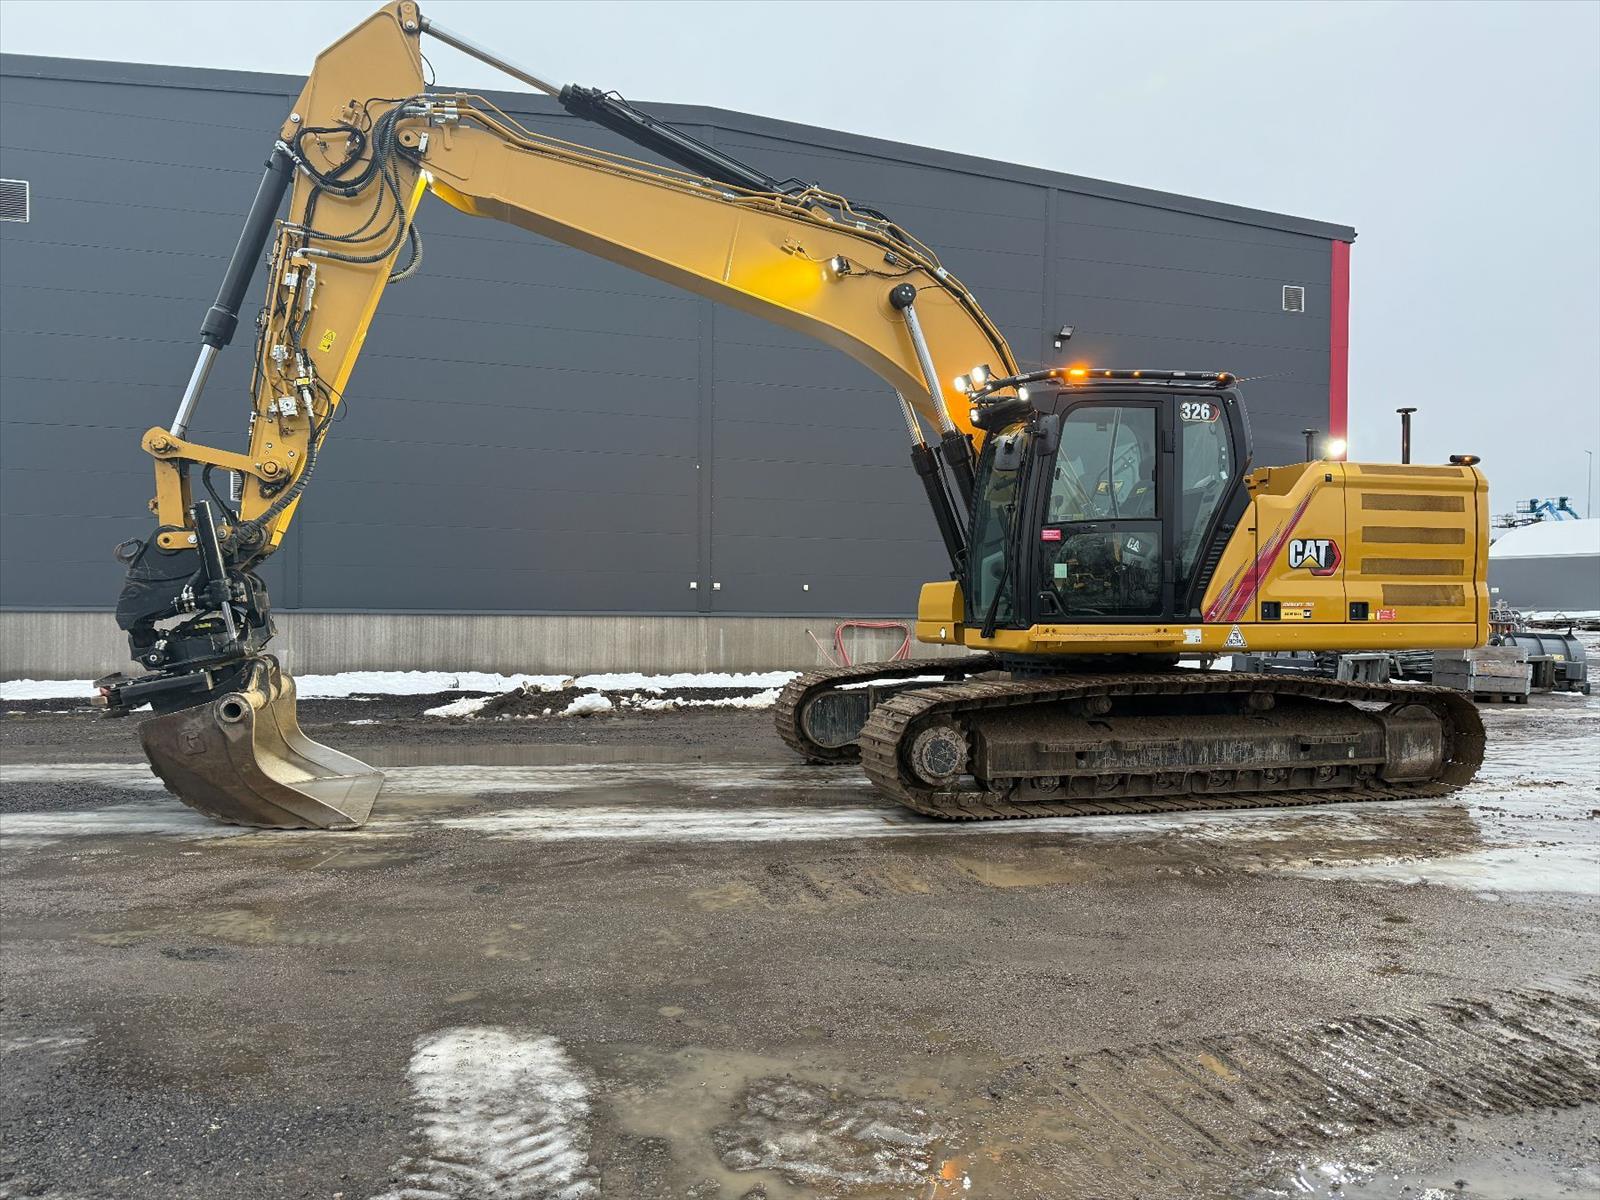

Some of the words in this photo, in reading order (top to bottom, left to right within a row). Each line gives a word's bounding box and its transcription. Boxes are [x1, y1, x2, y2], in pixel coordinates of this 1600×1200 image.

[1181, 402, 1210, 420] 326
[1126, 537, 1142, 553] CA
[1289, 539, 1330, 568] CAT
